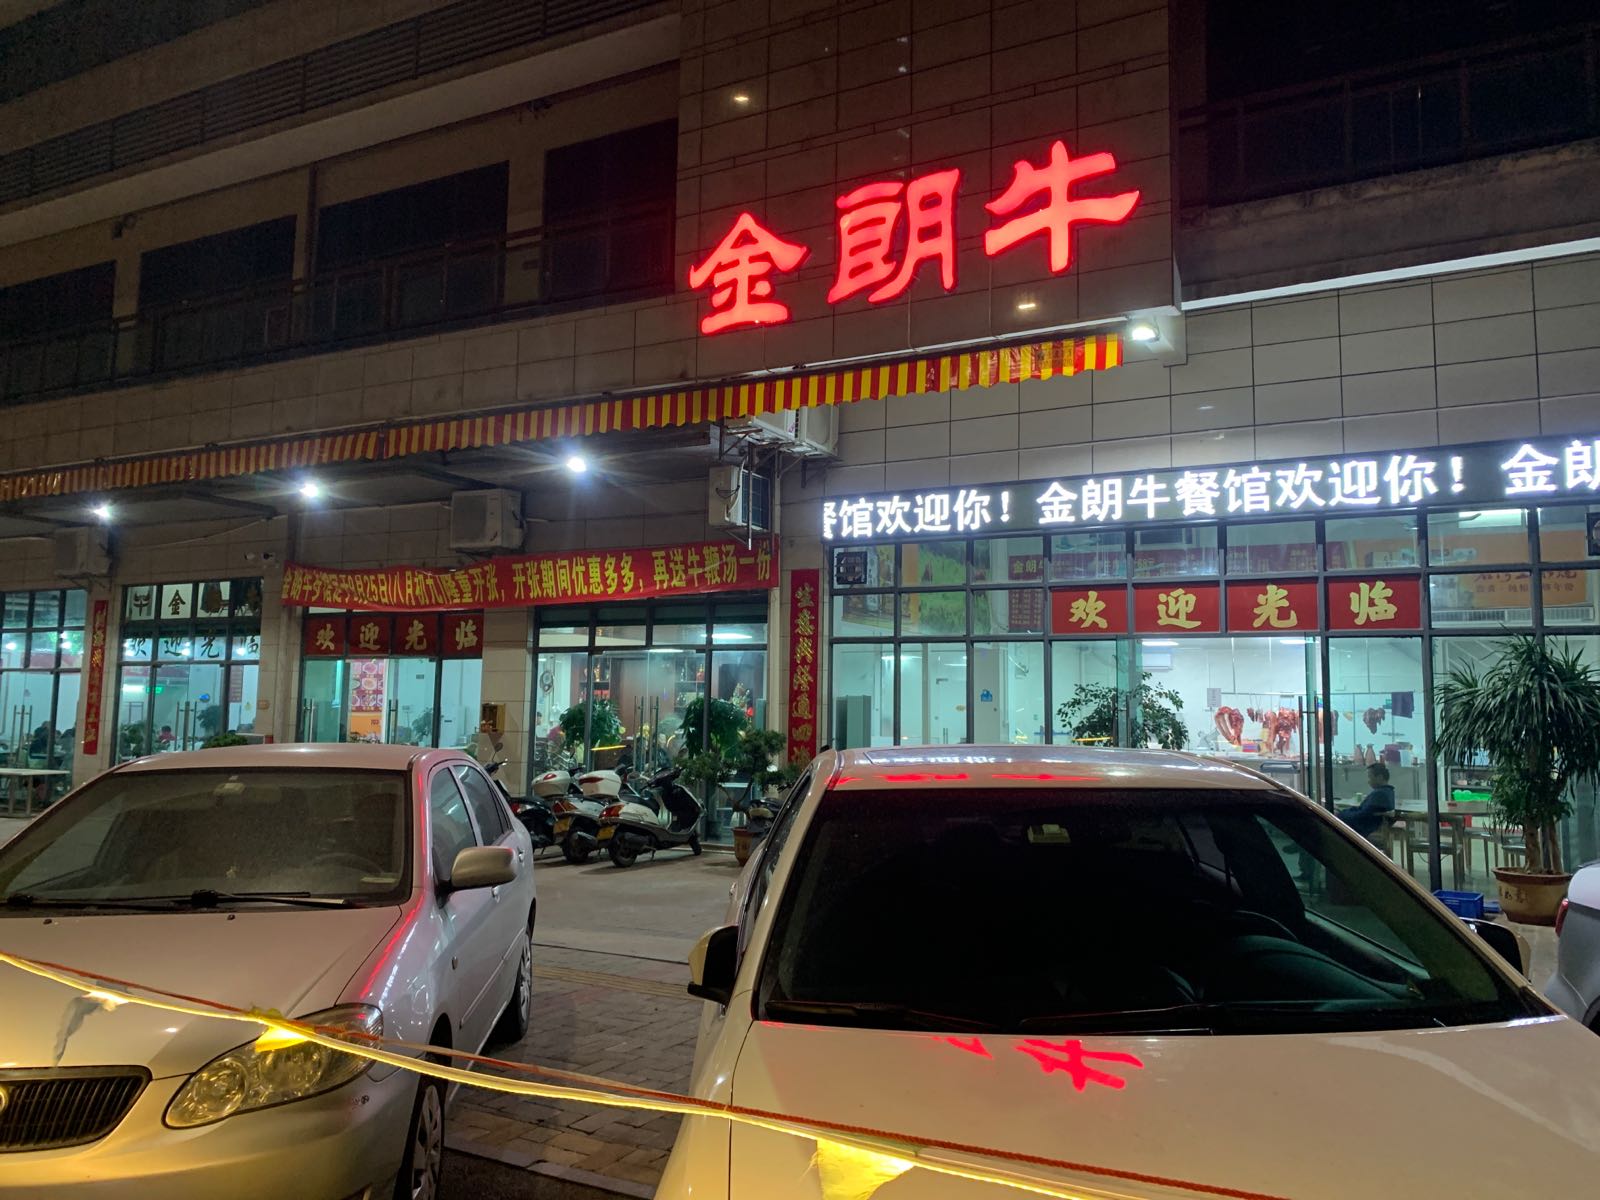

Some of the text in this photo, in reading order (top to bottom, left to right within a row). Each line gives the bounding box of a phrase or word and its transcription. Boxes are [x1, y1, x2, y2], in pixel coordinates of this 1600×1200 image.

[689, 140, 1140, 335] 金朗牛
[1037, 455, 1466, 525] 金朗牛餐馆欢迎你！
[1069, 580, 1398, 629] 欢迎光临
[316, 619, 478, 650] 欢迎光临
